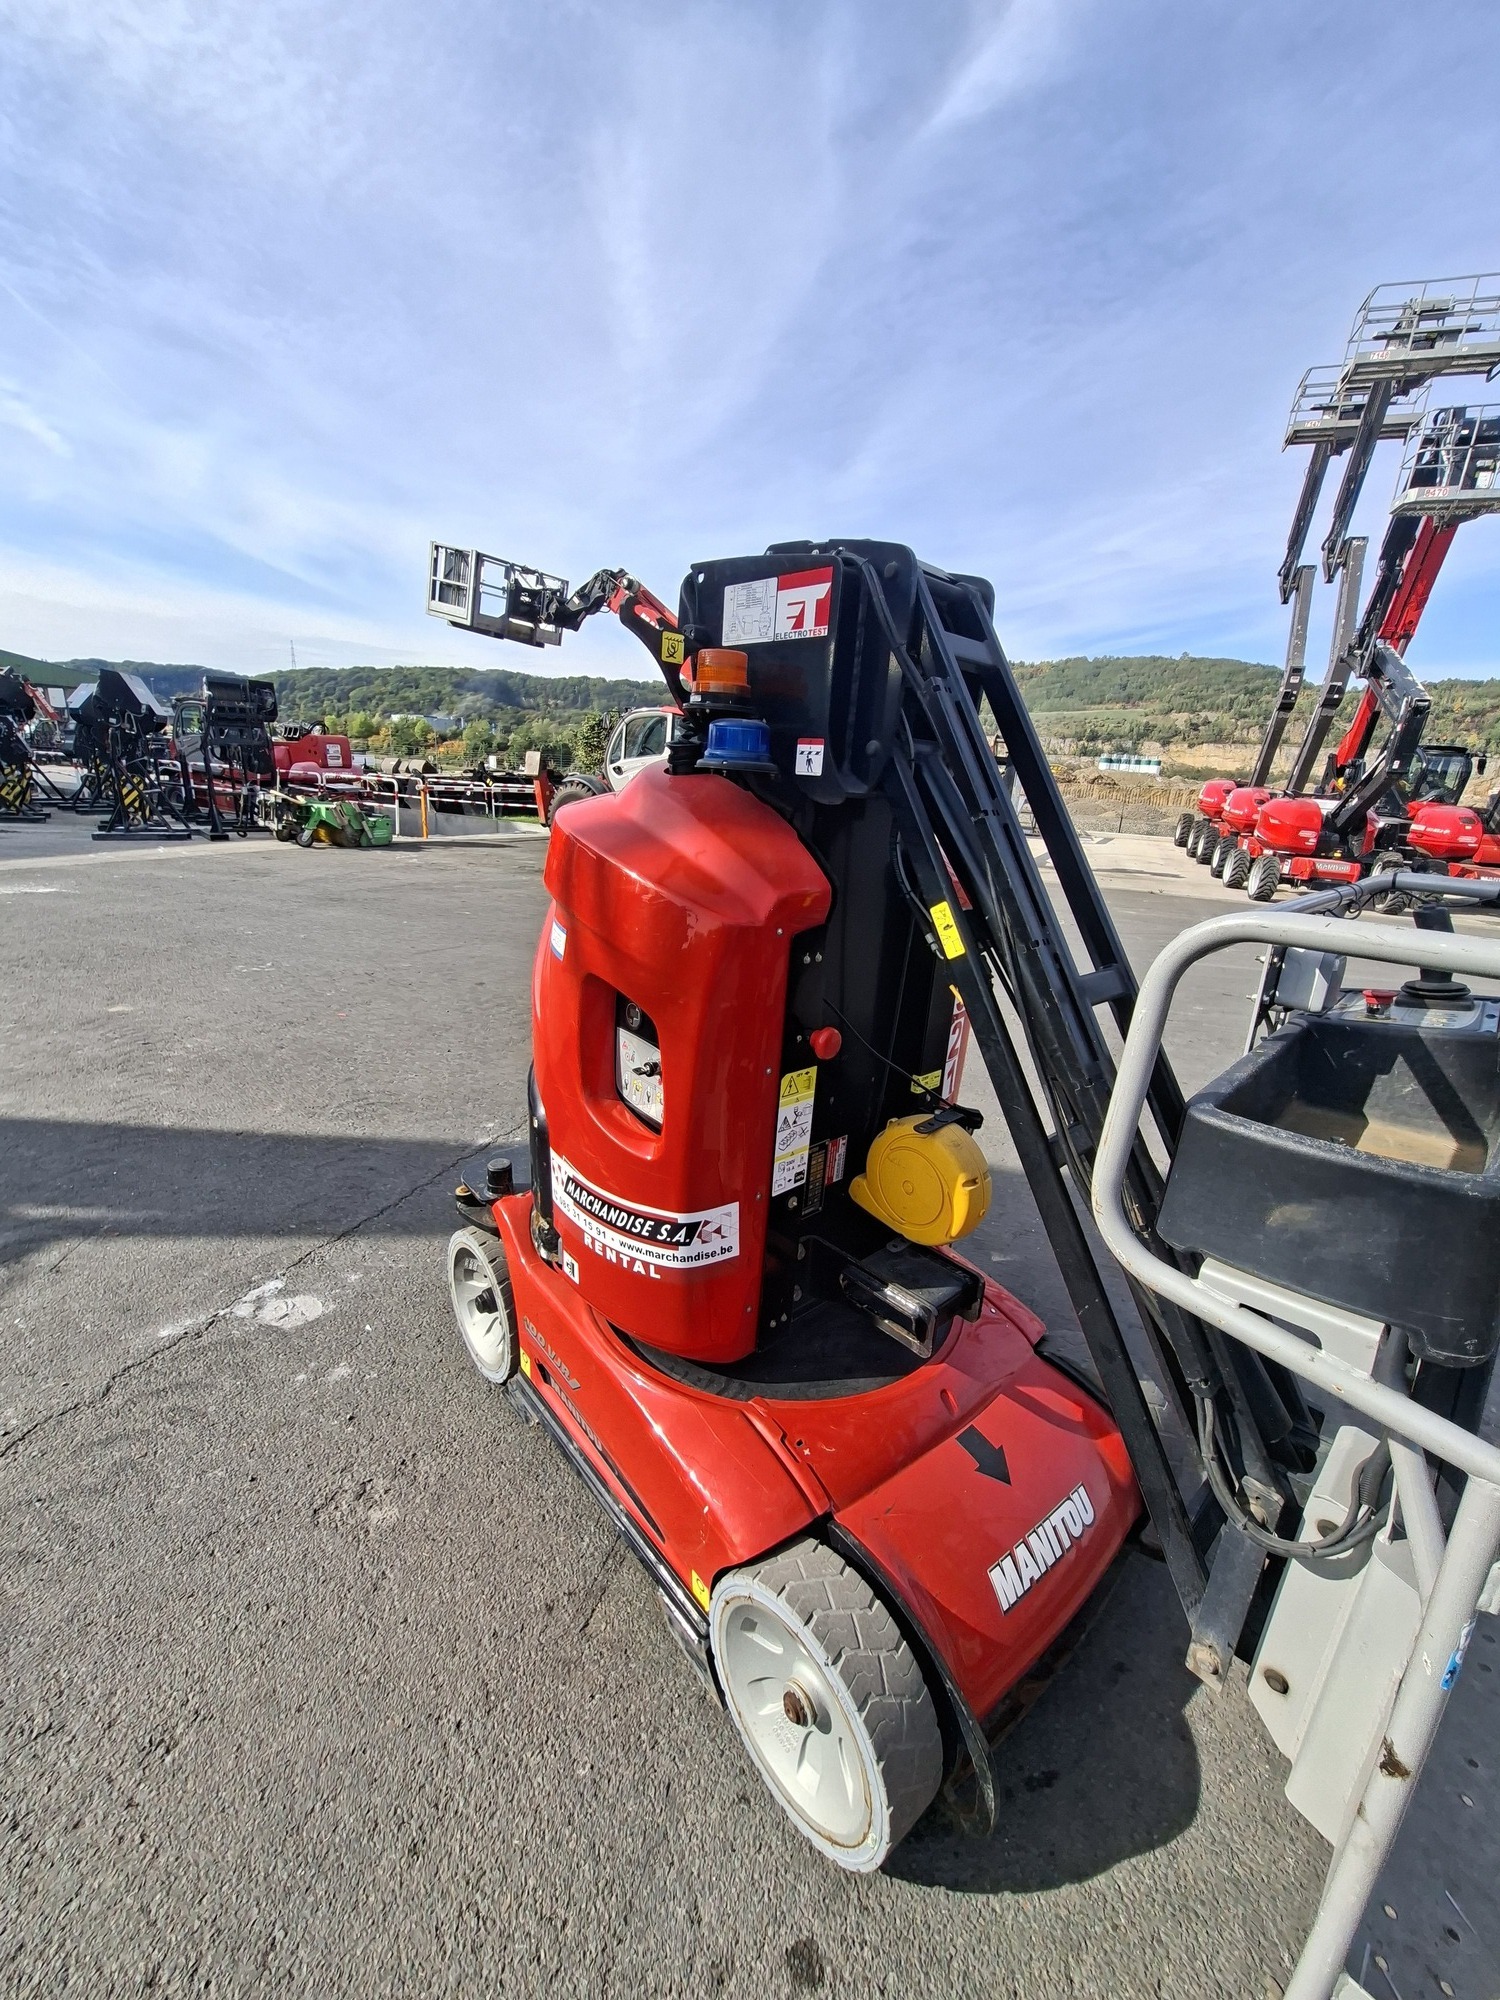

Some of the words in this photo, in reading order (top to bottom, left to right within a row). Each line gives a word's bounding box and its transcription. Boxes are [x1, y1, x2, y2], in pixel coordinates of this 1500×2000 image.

[775, 627, 828, 640] ELECTROTEST
[566, 1180, 655, 1237] MARCHANDISE
[656, 1224, 690, 1243] S.A.
[572, 1209, 581, 1221] 31
[583, 1218, 593, 1231] 15
[595, 1227, 607, 1240] 91
[619, 1239, 733, 1263] www.marchandise.be
[584, 1231, 661, 1279] RENTAL
[550, 1375, 603, 1452] MANITOU
[988, 1482, 1096, 1616] MANITOU
